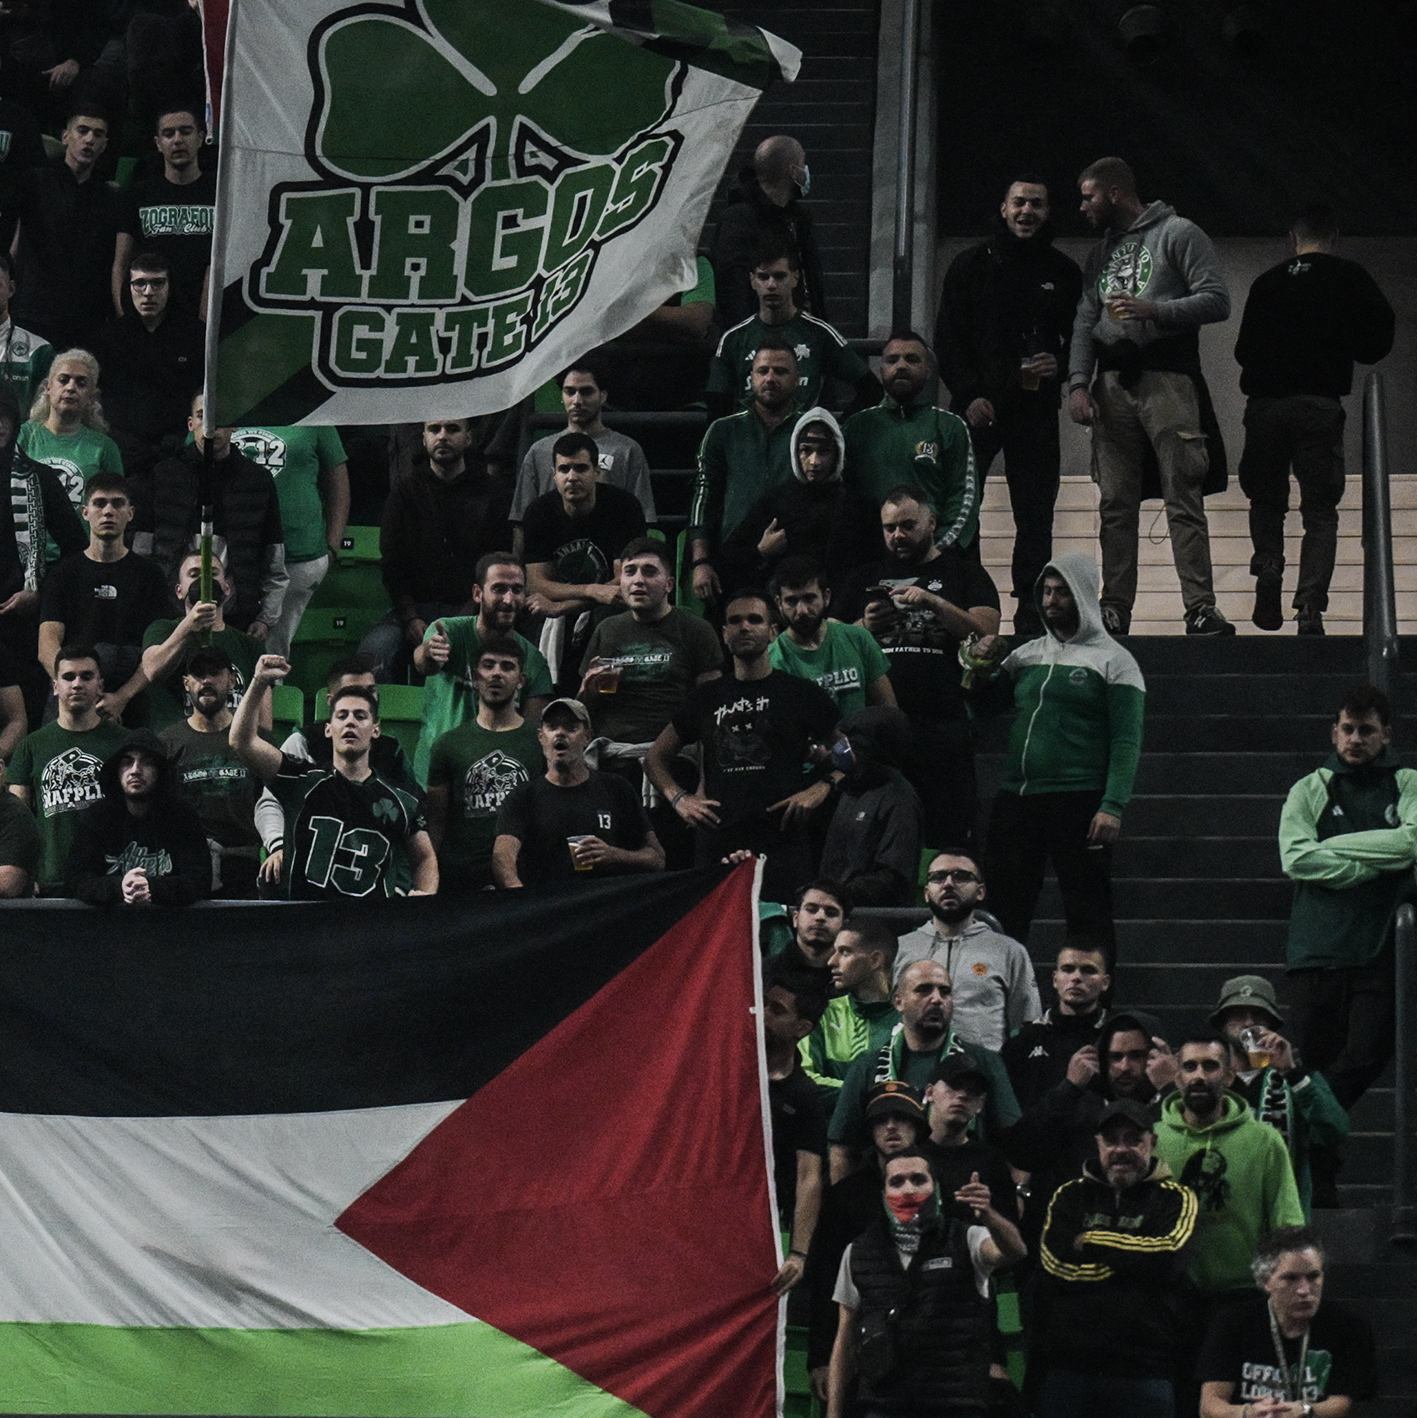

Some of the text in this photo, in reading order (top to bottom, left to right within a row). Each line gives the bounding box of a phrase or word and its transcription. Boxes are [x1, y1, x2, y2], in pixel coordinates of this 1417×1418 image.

[138, 206, 215, 238] ZOGRAFO
[263, 135, 671, 303] ARGOS
[332, 258, 593, 378] GATE 13
[305, 815, 392, 898] 13
[597, 813, 612, 830] 13
